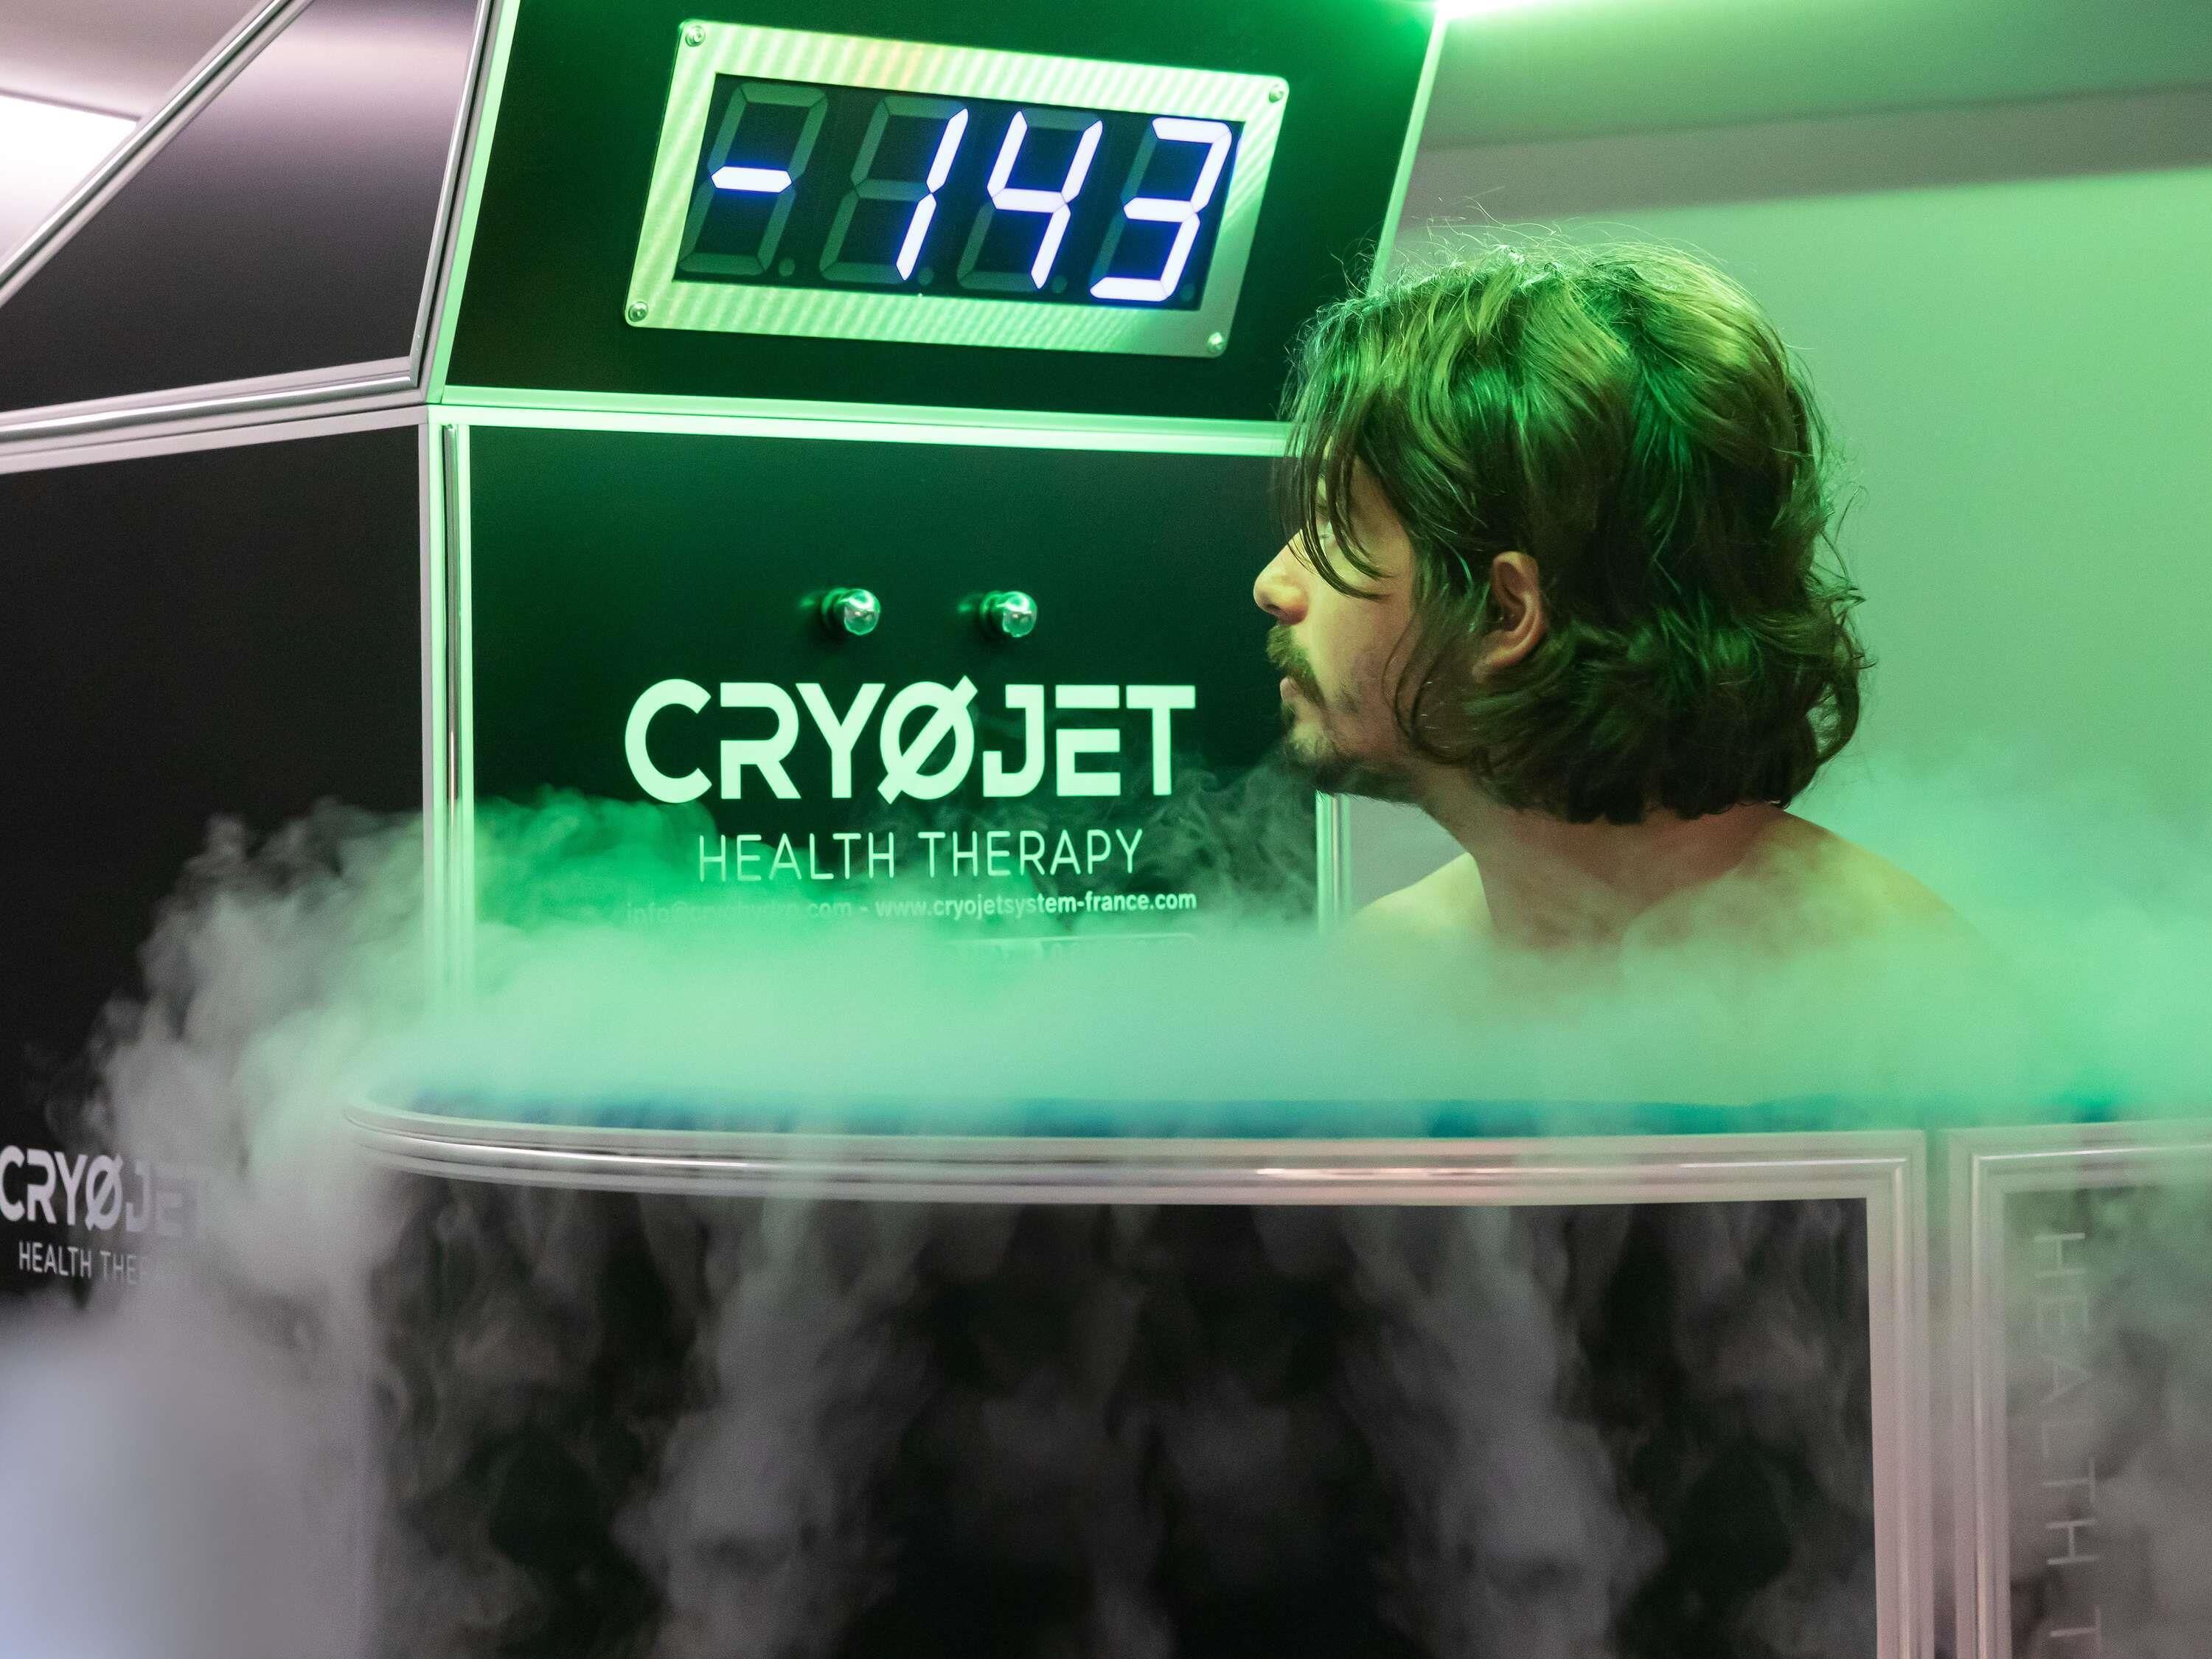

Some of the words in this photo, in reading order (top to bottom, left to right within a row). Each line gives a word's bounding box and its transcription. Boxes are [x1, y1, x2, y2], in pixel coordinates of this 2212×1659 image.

[699, 832, 894, 881] HEALTH
[918, 829, 1143, 877] THERAPY
[875, 891, 1197, 919] www.cryojetsystem-france.com
[18, 1239, 92, 1279] HEALTH
[2034, 1231, 2101, 1565] HEALTH
